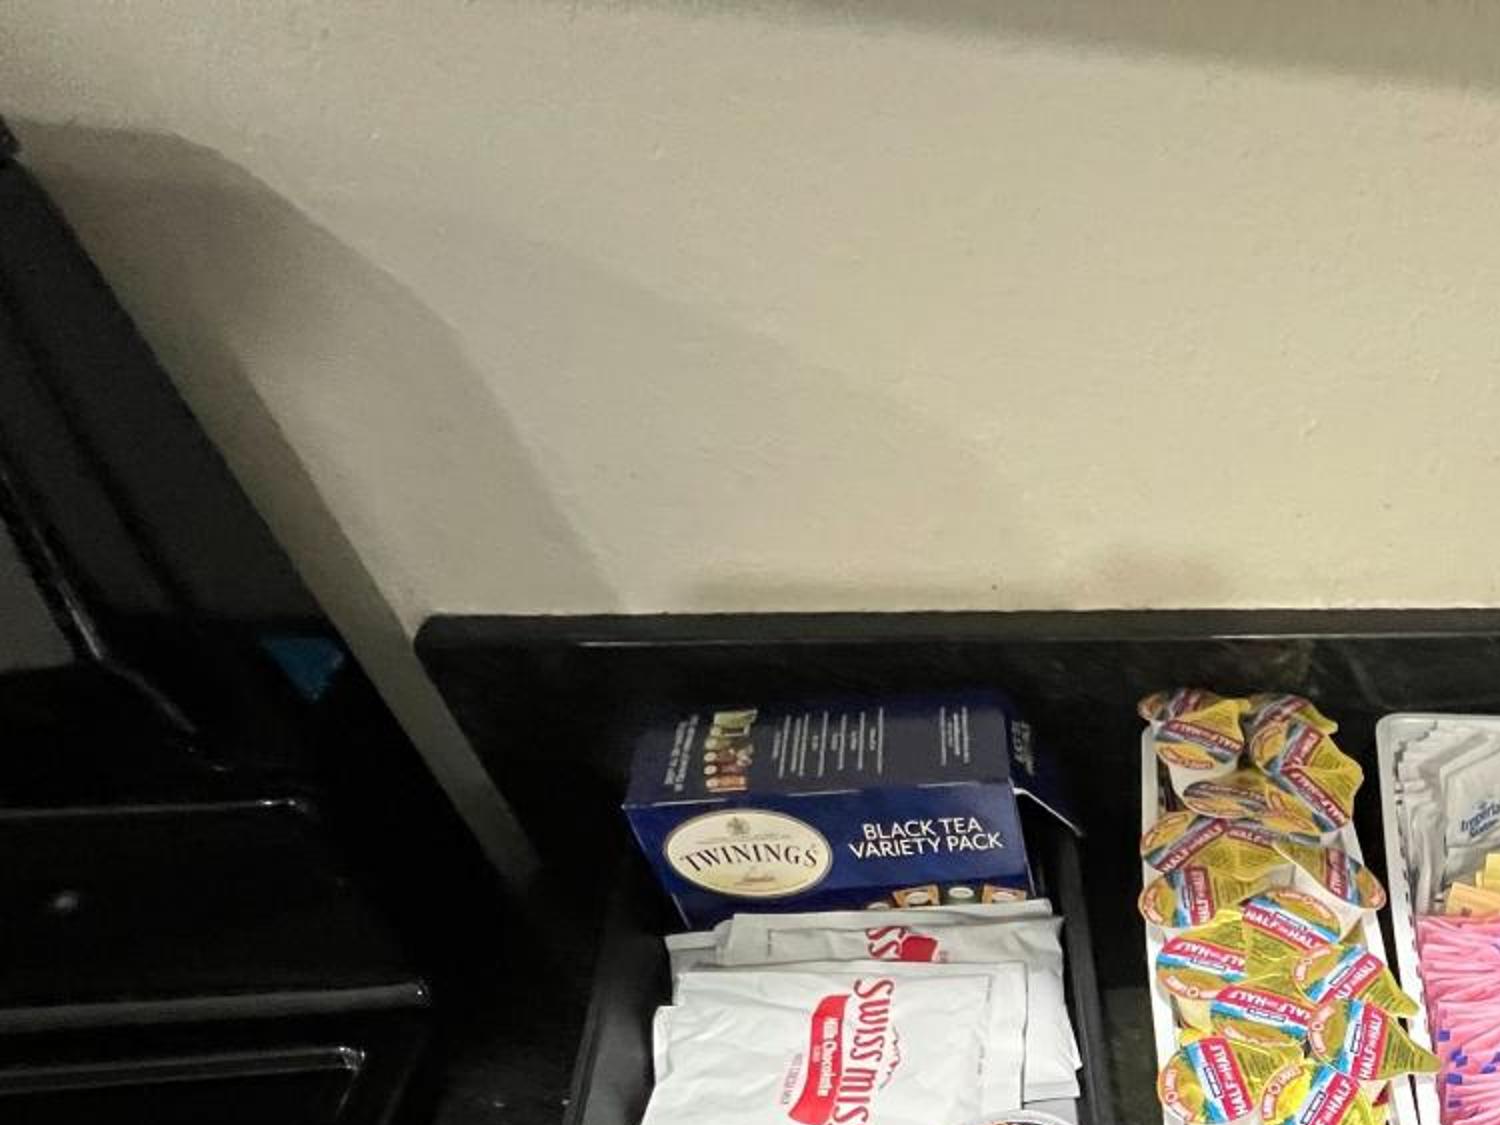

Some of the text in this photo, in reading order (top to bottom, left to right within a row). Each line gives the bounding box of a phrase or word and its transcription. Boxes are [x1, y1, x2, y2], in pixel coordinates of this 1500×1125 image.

[863, 816, 982, 840] BLACK TEA
[679, 843, 817, 871] TWININGS
[849, 832, 1003, 859] VARIETY PACK
[851, 979, 895, 1062] SWISS
[1280, 1003, 1311, 1021] ALF
[1210, 1044, 1233, 1073] HALF
[1360, 1045, 1378, 1080] HALF
[1230, 1088, 1249, 1118] HALF
[1328, 1077, 1353, 1114] HALF
